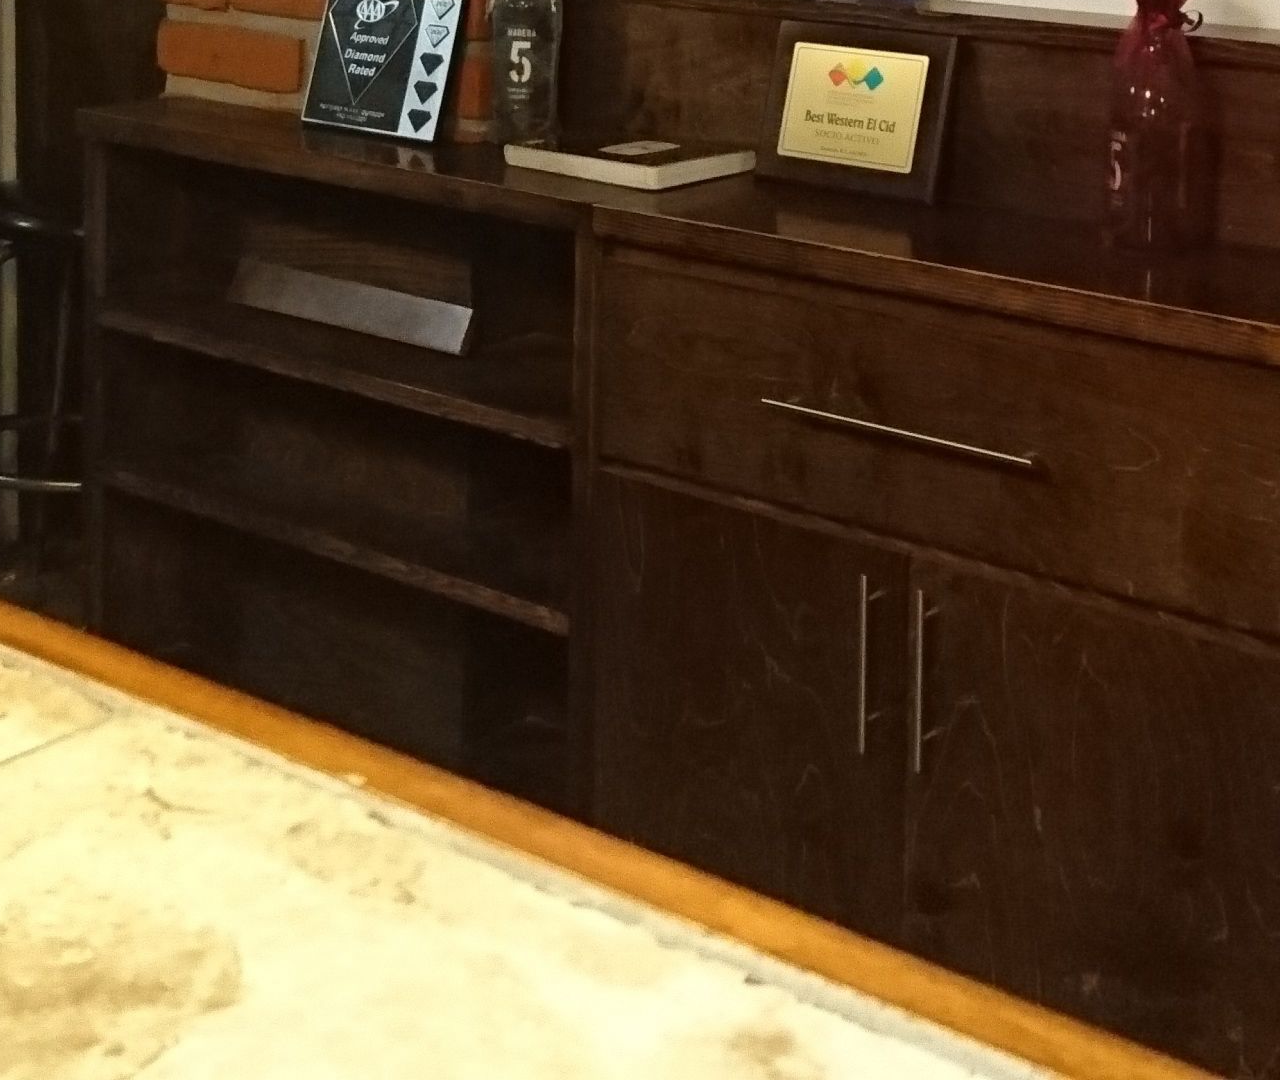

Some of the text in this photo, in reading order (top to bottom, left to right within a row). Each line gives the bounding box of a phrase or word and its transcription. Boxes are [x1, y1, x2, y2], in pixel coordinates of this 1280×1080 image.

[357, 0, 386, 22] AAA
[349, 31, 390, 46] Approved
[344, 47, 386, 64] Diamond
[509, 40, 532, 83] 5
[347, 63, 376, 77] Rated
[804, 109, 896, 133] Best Western El Cid
